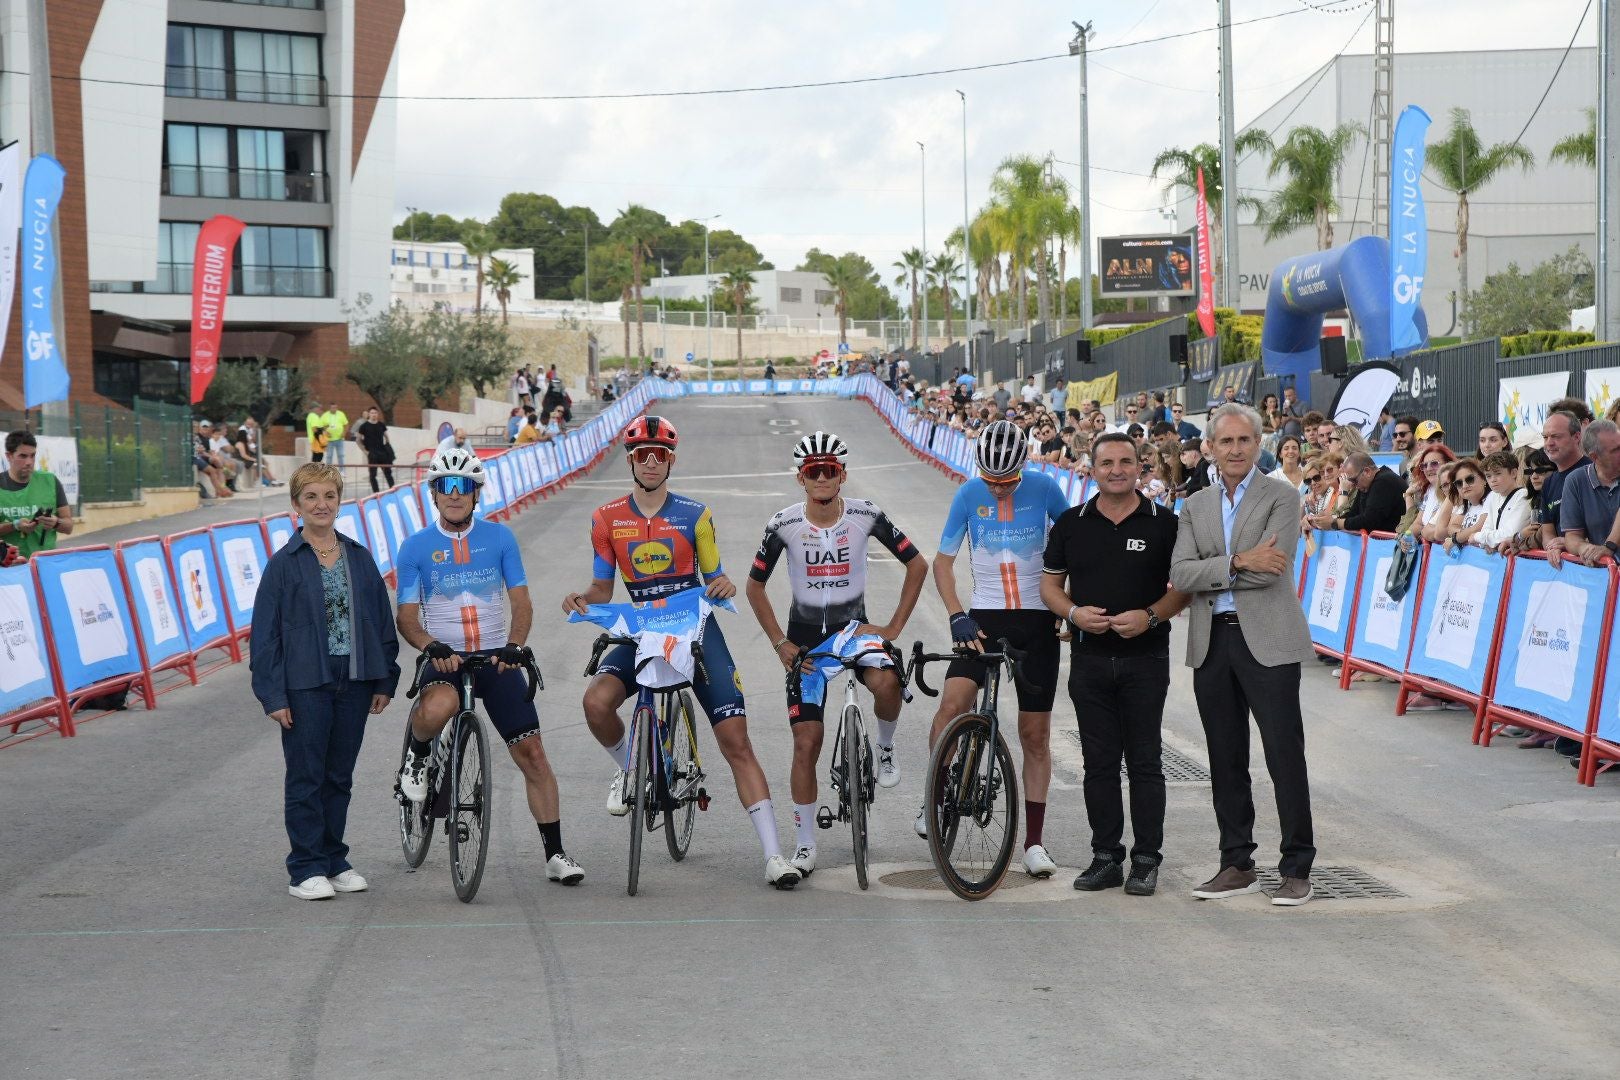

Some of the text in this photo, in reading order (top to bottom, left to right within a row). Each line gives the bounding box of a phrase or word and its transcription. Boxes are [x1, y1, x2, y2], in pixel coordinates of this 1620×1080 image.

[1403, 232, 1416, 254] LA
[200, 244, 227, 330] CRITERIUM
[1393, 275, 1423, 304] GF
[32, 286, 44, 309] LA
[27, 331, 54, 361] GF
[612, 519, 638, 527] Santini
[987, 526, 1037, 536] GENERALITAT
[988, 534, 1037, 543] VALENCIANA
[1126, 538, 1146, 551] DG
[805, 547, 850, 565] UAE
[443, 567, 496, 582] GENERALITAT
[445, 575, 496, 588] VALENCIANA
[630, 581, 692, 597] TREK
[807, 580, 850, 590] XRG
[647, 609, 690, 624] GENERALITAT
[722, 708, 746, 717] TR
